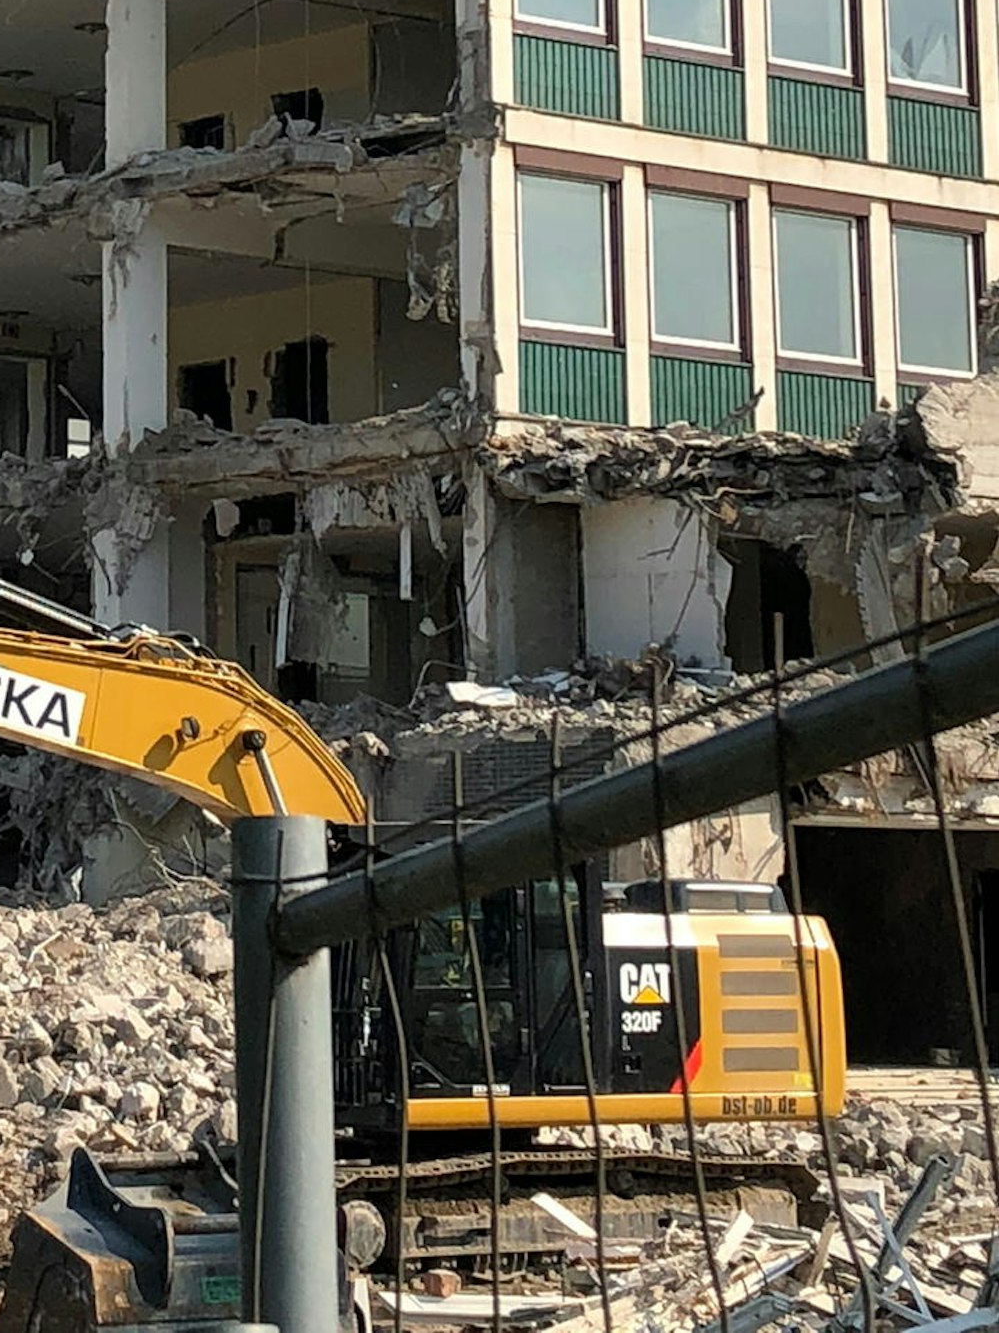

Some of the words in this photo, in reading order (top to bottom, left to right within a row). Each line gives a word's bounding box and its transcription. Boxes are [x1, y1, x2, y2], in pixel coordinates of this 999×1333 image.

[619, 963, 671, 1004] CAT
[621, 1010, 662, 1033] 320F
[722, 1095, 797, 1115] bst-ob.de
